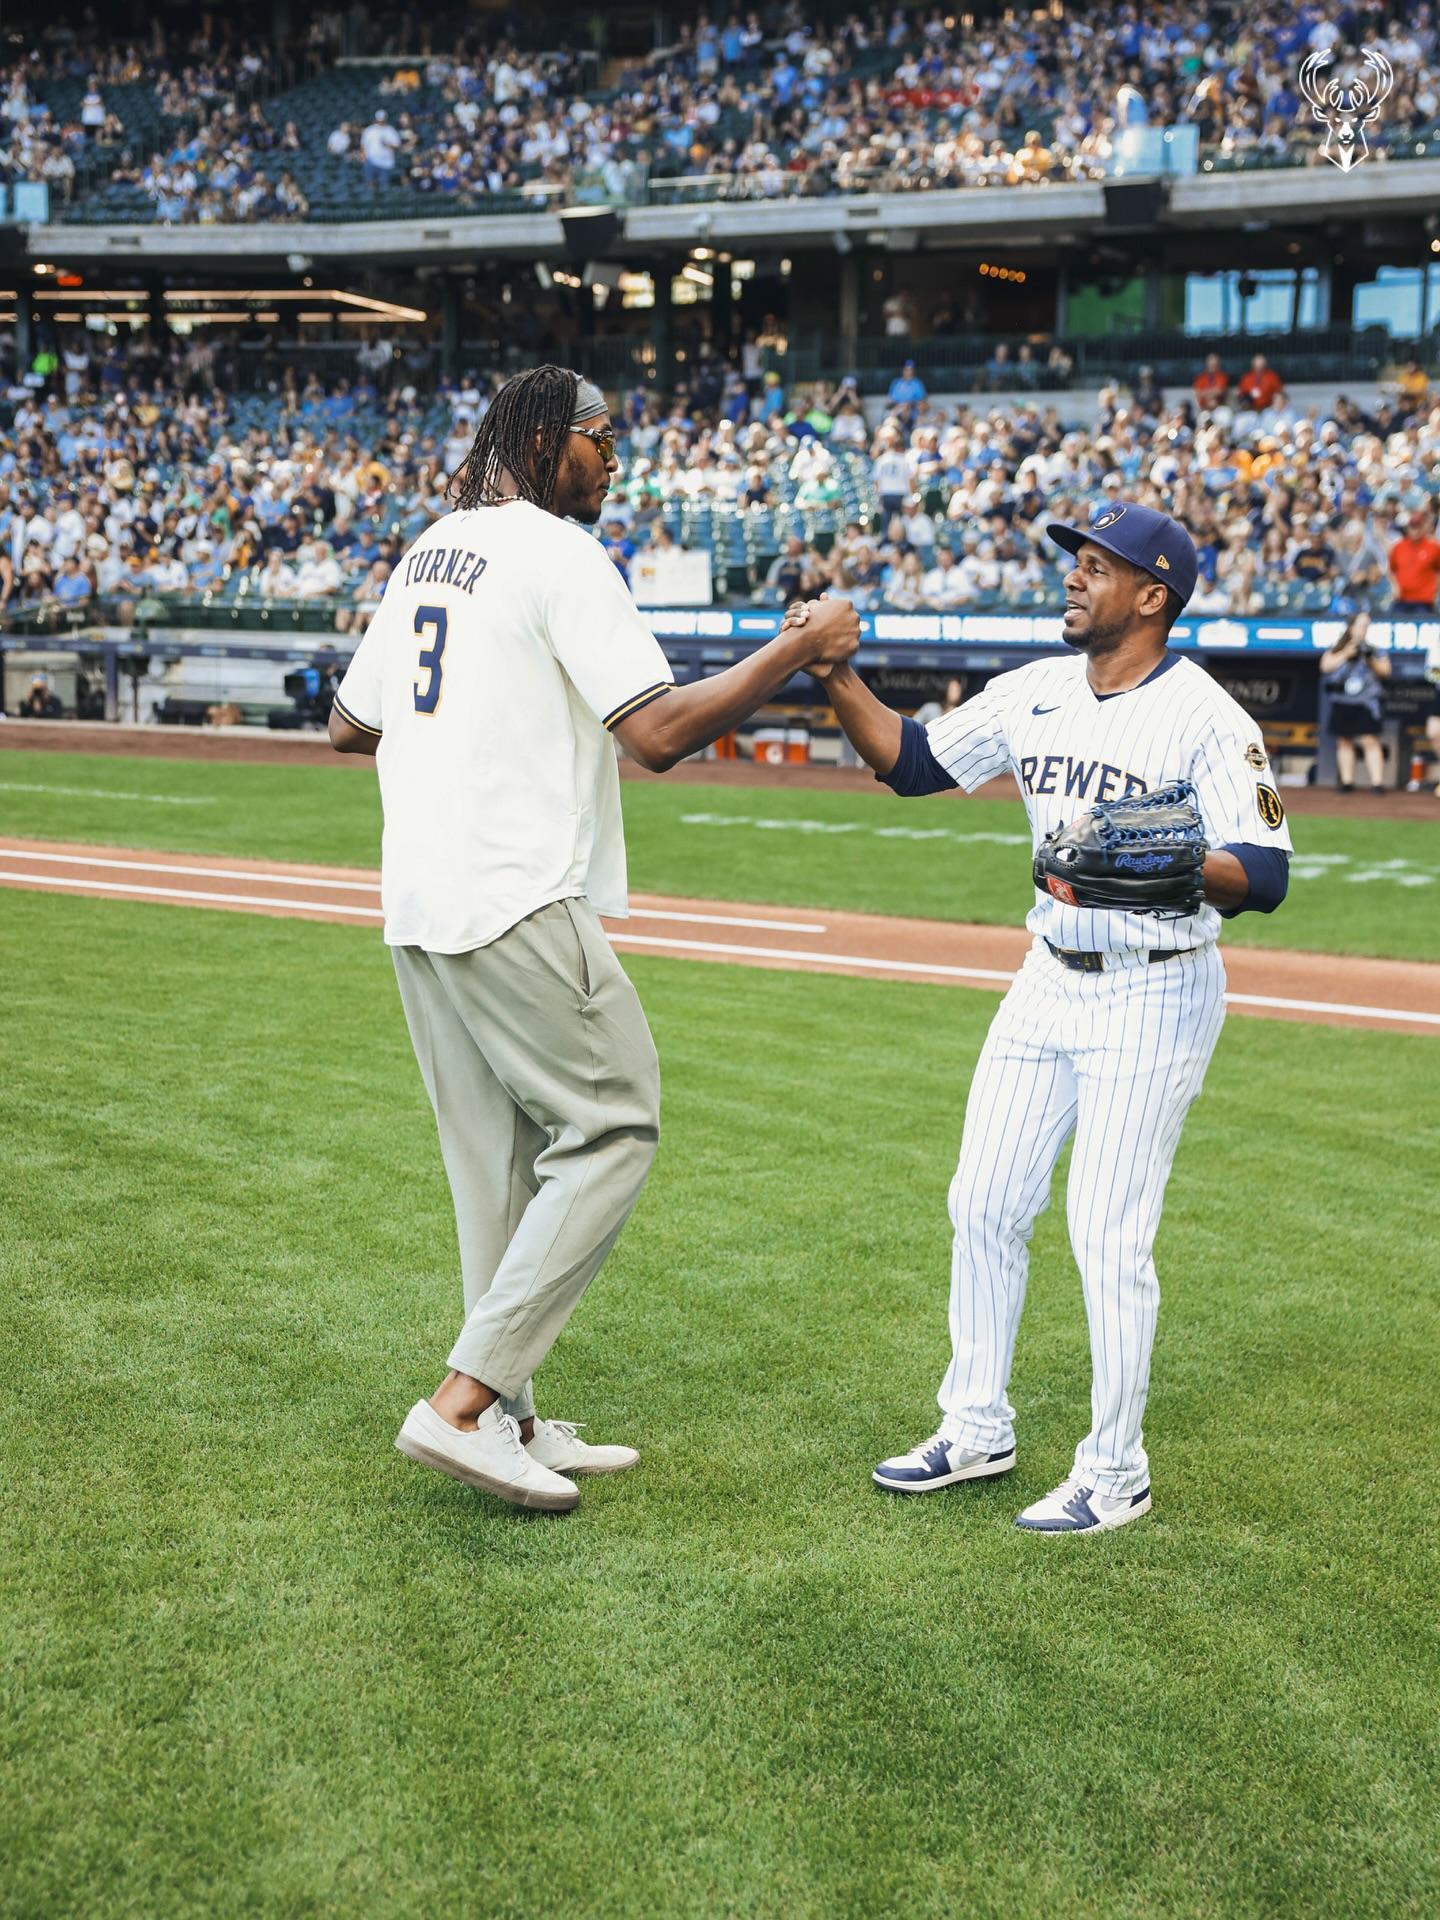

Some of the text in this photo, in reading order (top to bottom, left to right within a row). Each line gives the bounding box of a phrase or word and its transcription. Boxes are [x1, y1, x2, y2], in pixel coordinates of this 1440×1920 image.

[405, 549, 488, 595] TURNER
[412, 602, 448, 717] 3
[1115, 852, 1174, 872] Rawlings
